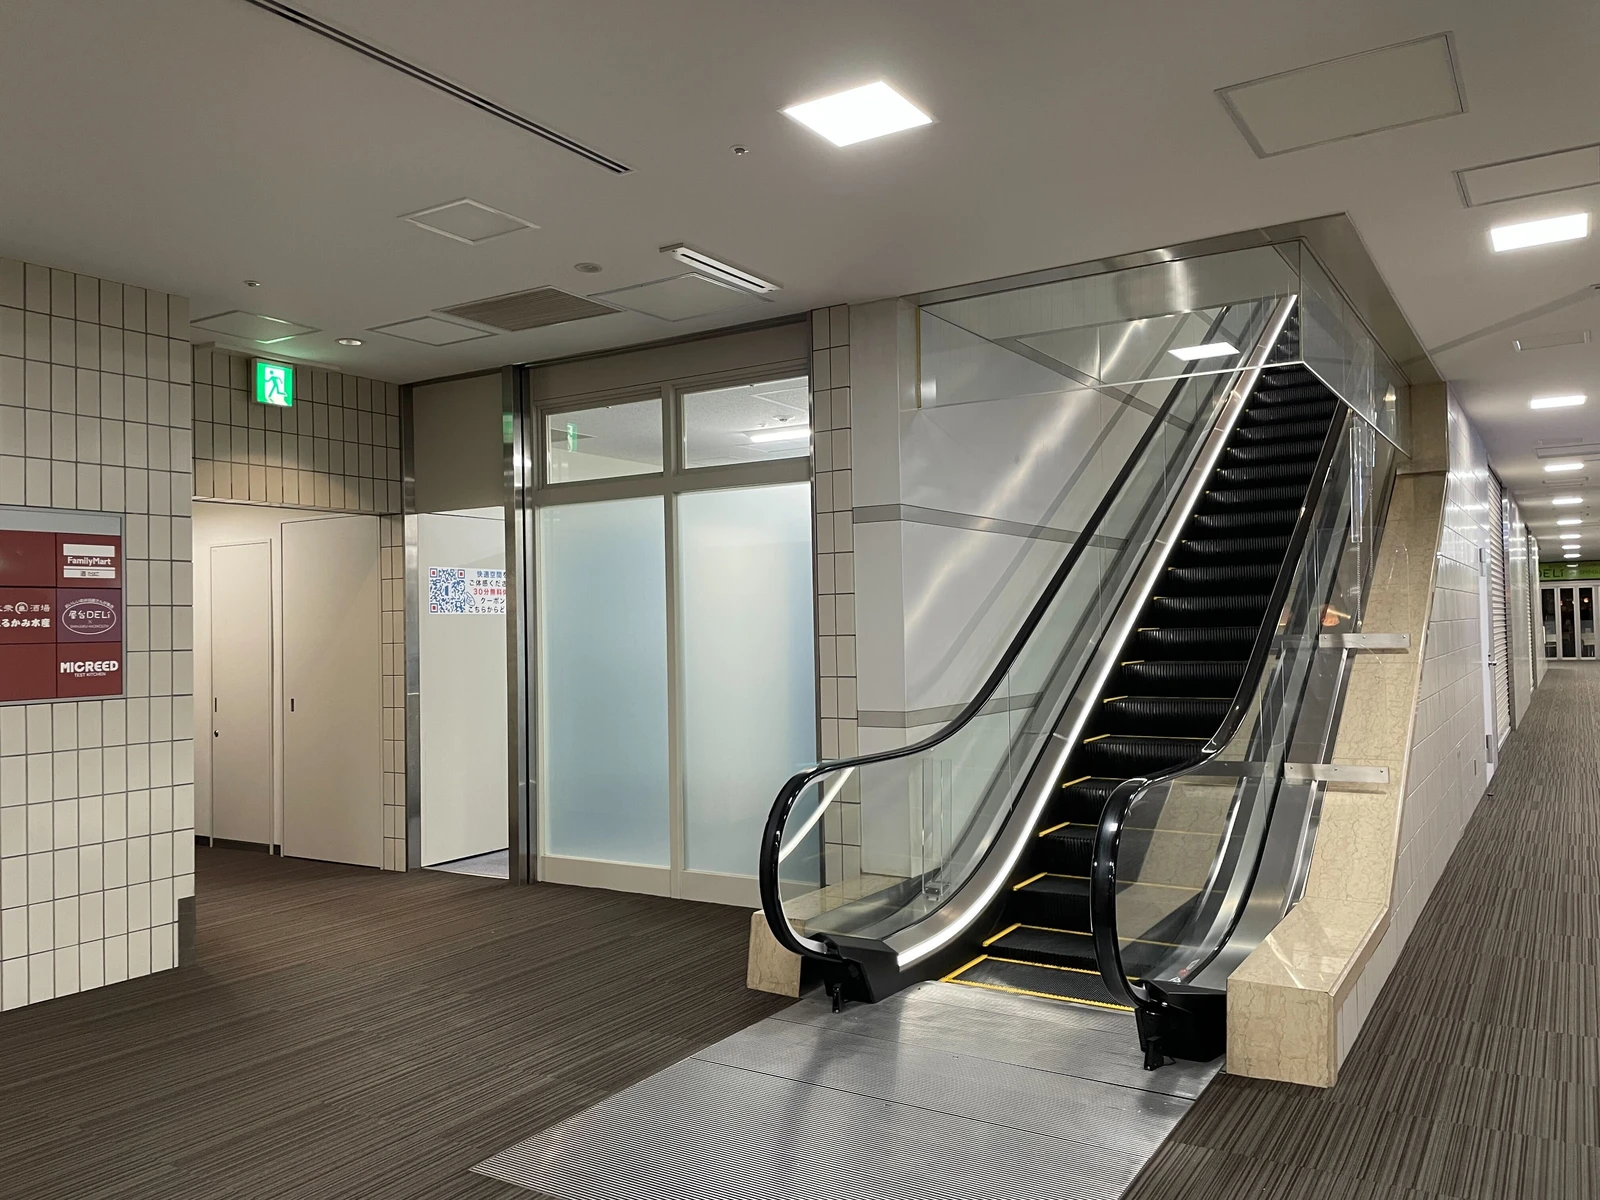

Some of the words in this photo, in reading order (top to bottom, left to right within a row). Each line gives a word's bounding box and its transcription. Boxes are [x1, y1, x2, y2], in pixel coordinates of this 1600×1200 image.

[67, 556, 111, 566] FamilyMart
[0, 618, 51, 628] るかみ水産
